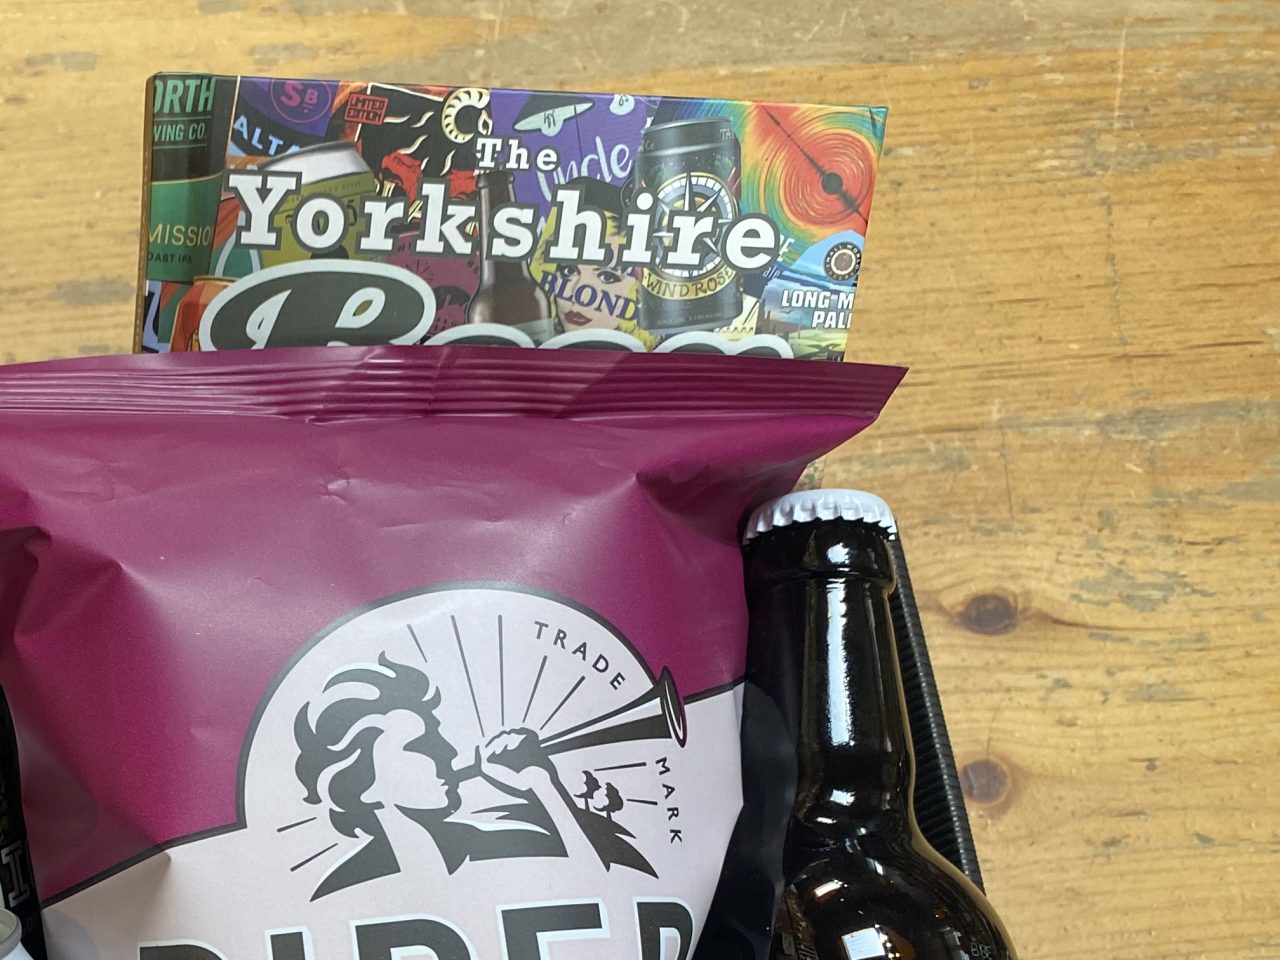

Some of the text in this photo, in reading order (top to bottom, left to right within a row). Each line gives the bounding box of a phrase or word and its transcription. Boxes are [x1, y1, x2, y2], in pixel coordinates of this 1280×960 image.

[476, 136, 559, 171] The
[227, 173, 776, 270] Yorkshire
[781, 290, 832, 311] LONG
[534, 619, 626, 691] TRADE
[655, 756, 683, 844] MARK
